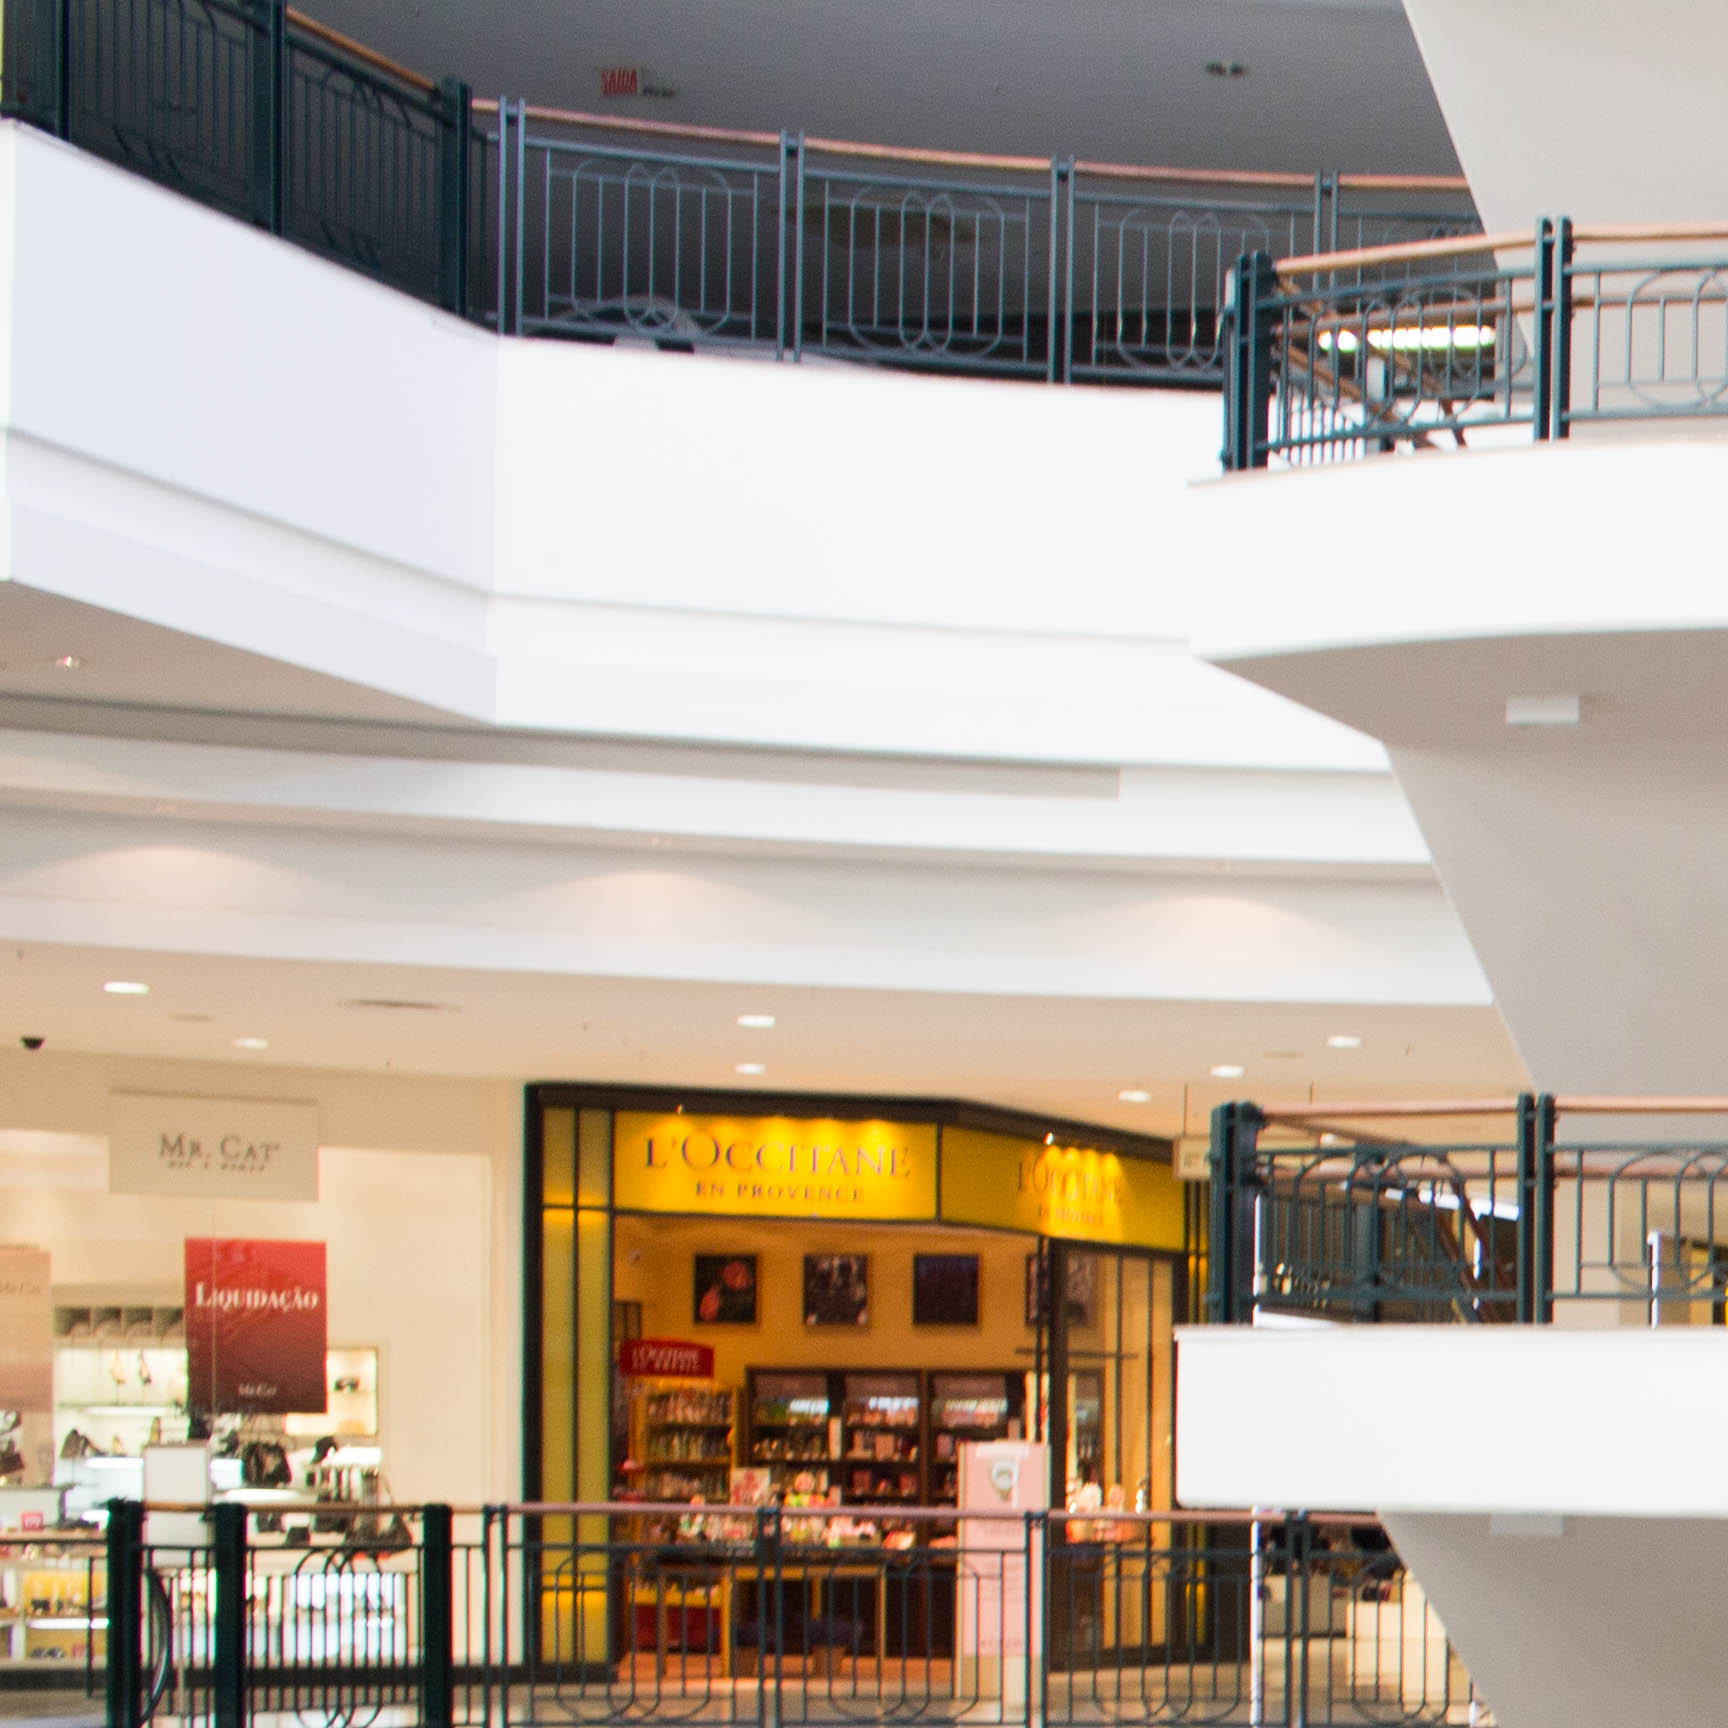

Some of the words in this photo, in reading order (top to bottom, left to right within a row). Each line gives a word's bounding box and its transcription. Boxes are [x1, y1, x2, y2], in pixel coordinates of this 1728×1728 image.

[646, 1130, 912, 1178] L'OCCITANE
[695, 1180, 725, 1199] EN
[737, 1183, 865, 1202] PROVENCE
[195, 1281, 320, 1314] LIQUIDAÇÃO
